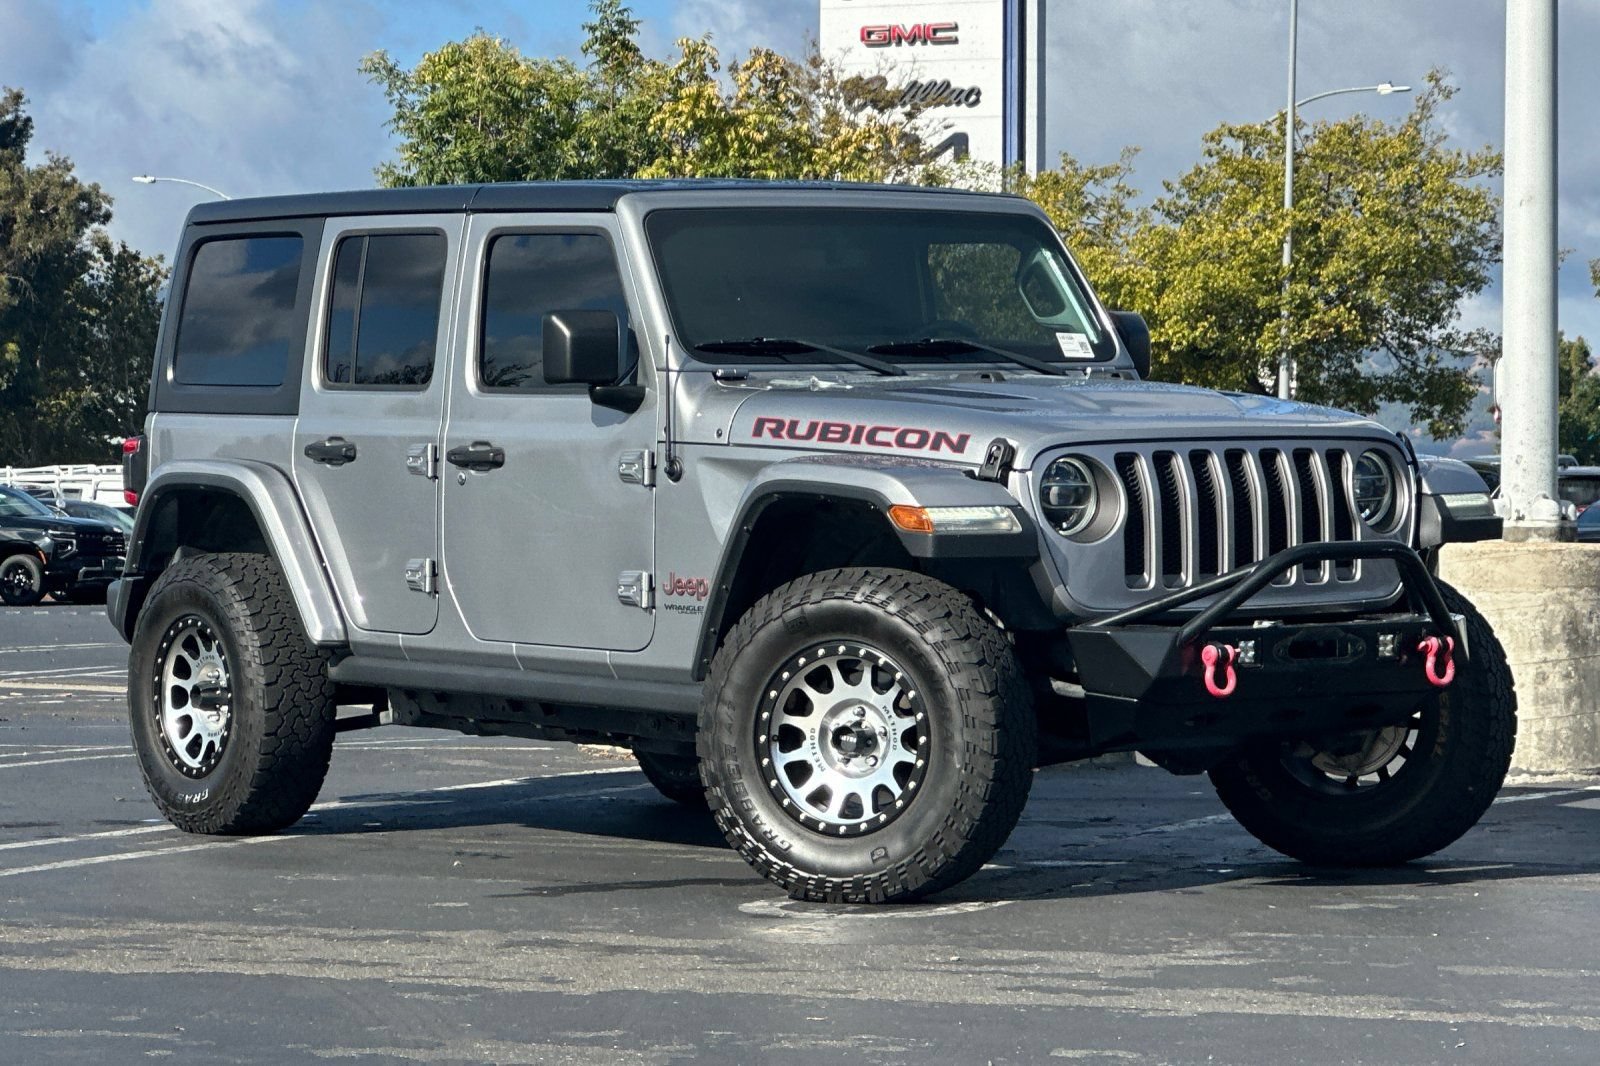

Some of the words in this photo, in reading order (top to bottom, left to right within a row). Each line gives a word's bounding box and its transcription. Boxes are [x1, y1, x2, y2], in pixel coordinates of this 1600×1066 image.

[860, 21, 959, 47] GMC
[752, 416, 971, 454] RUBICON
[662, 571, 709, 601] Jeep
[882, 705, 898, 750] METHOD
[810, 728, 826, 772] METHOD
